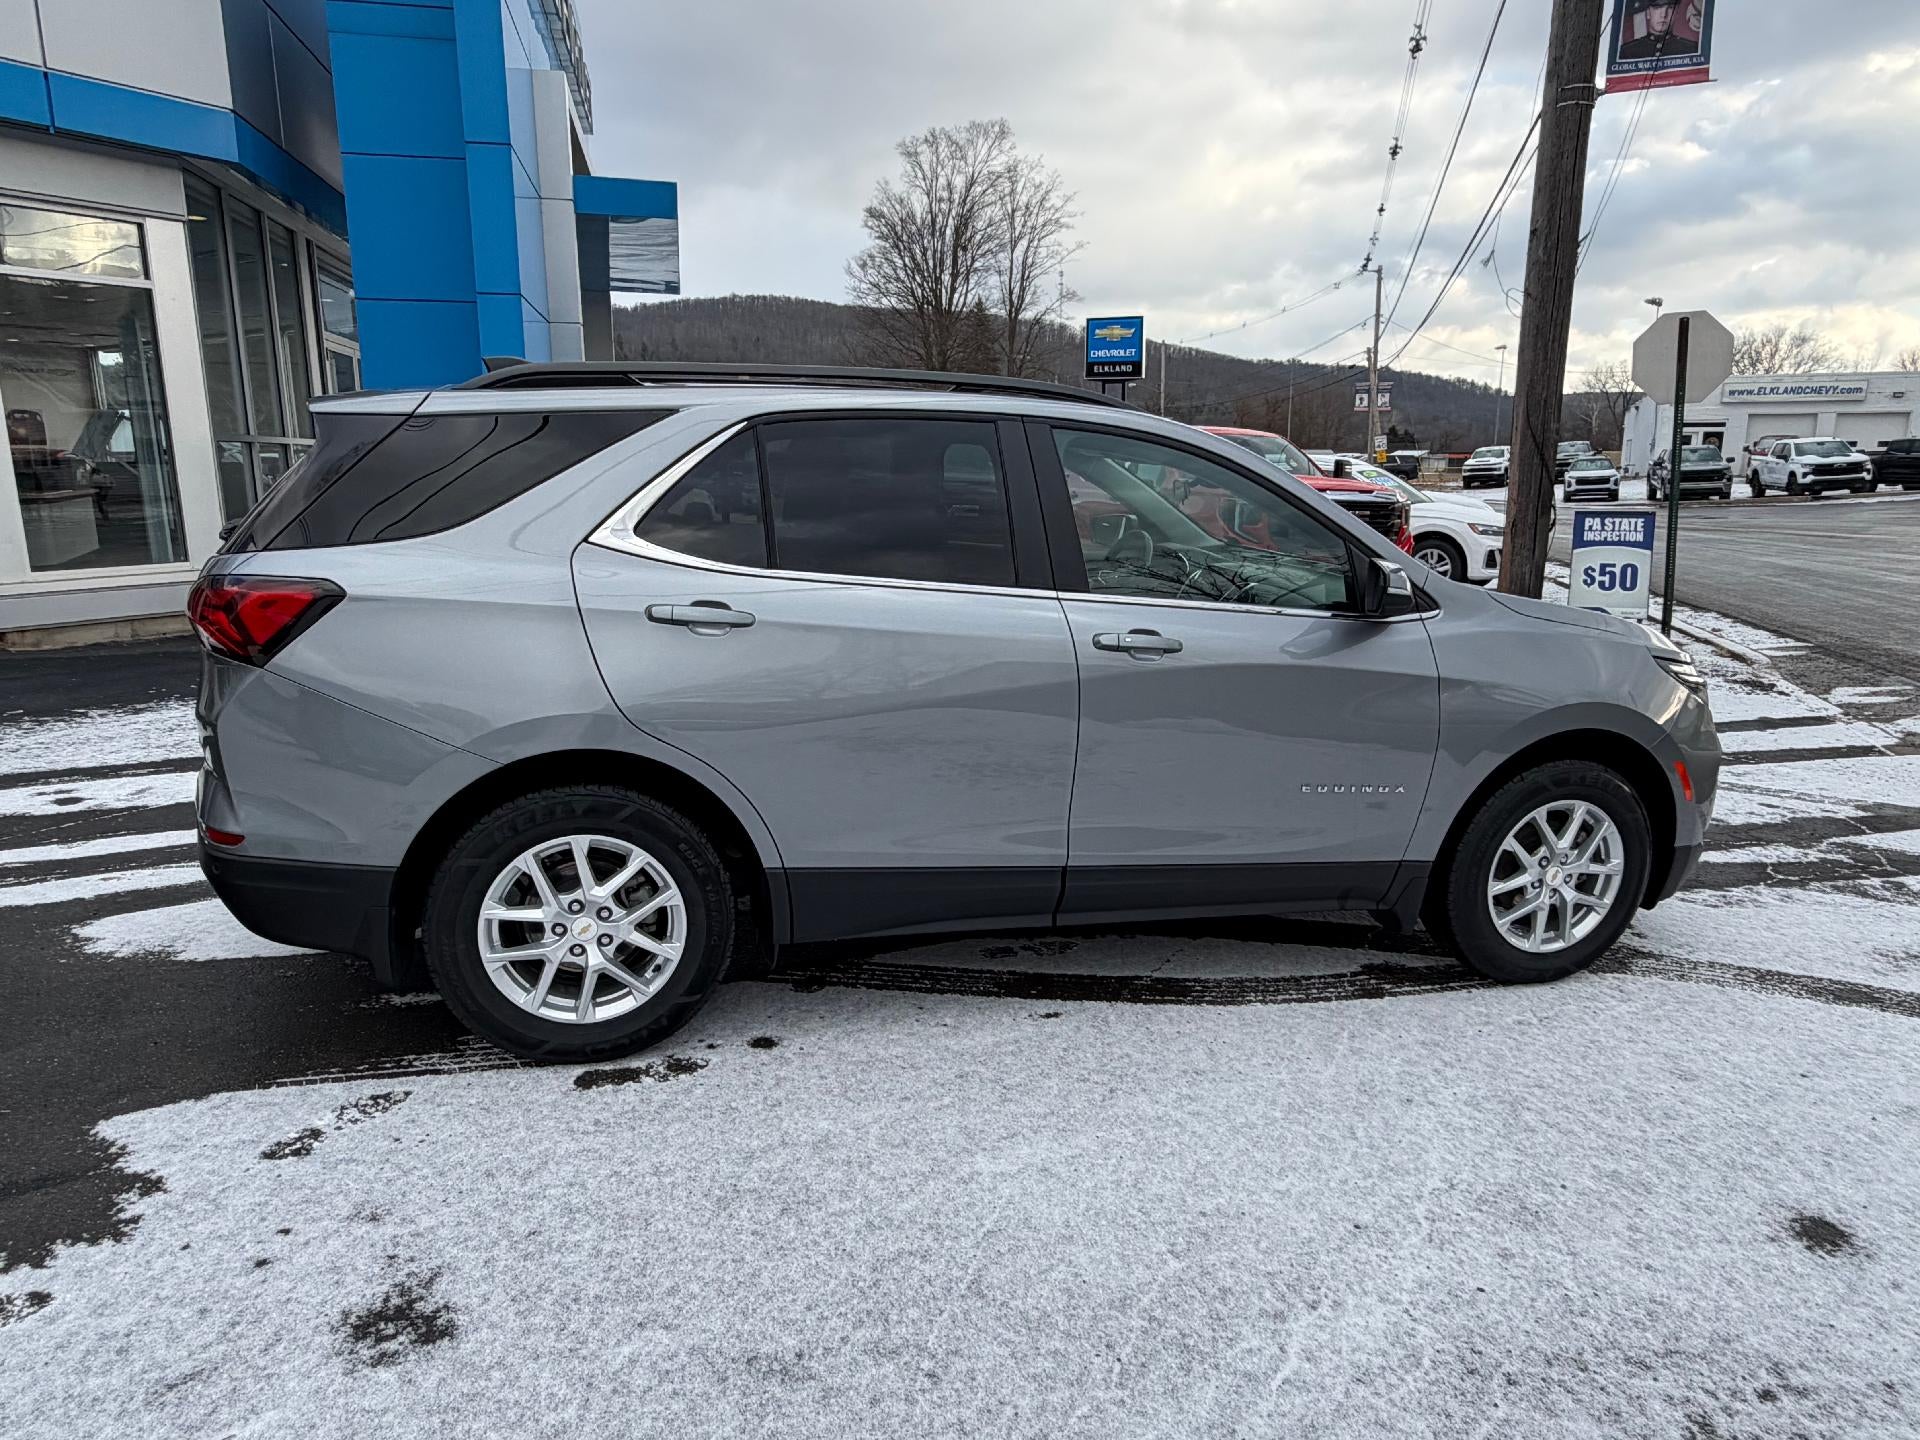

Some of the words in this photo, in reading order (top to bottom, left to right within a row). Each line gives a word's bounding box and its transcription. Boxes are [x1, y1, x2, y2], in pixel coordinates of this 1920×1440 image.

[1611, 63, 1636, 71] GLOBAL
[1091, 349, 1136, 357] CHEVROLET
[1094, 365, 1132, 373] ELKLAND
[1728, 385, 1863, 397] www.ELKLANDCHEVY.com
[1584, 518, 1602, 531] PA
[1604, 518, 1645, 531] STATE
[1584, 532, 1643, 541] INSPECTION
[1582, 563, 1639, 592] $50
[1301, 783, 1405, 793] EQUINOX
